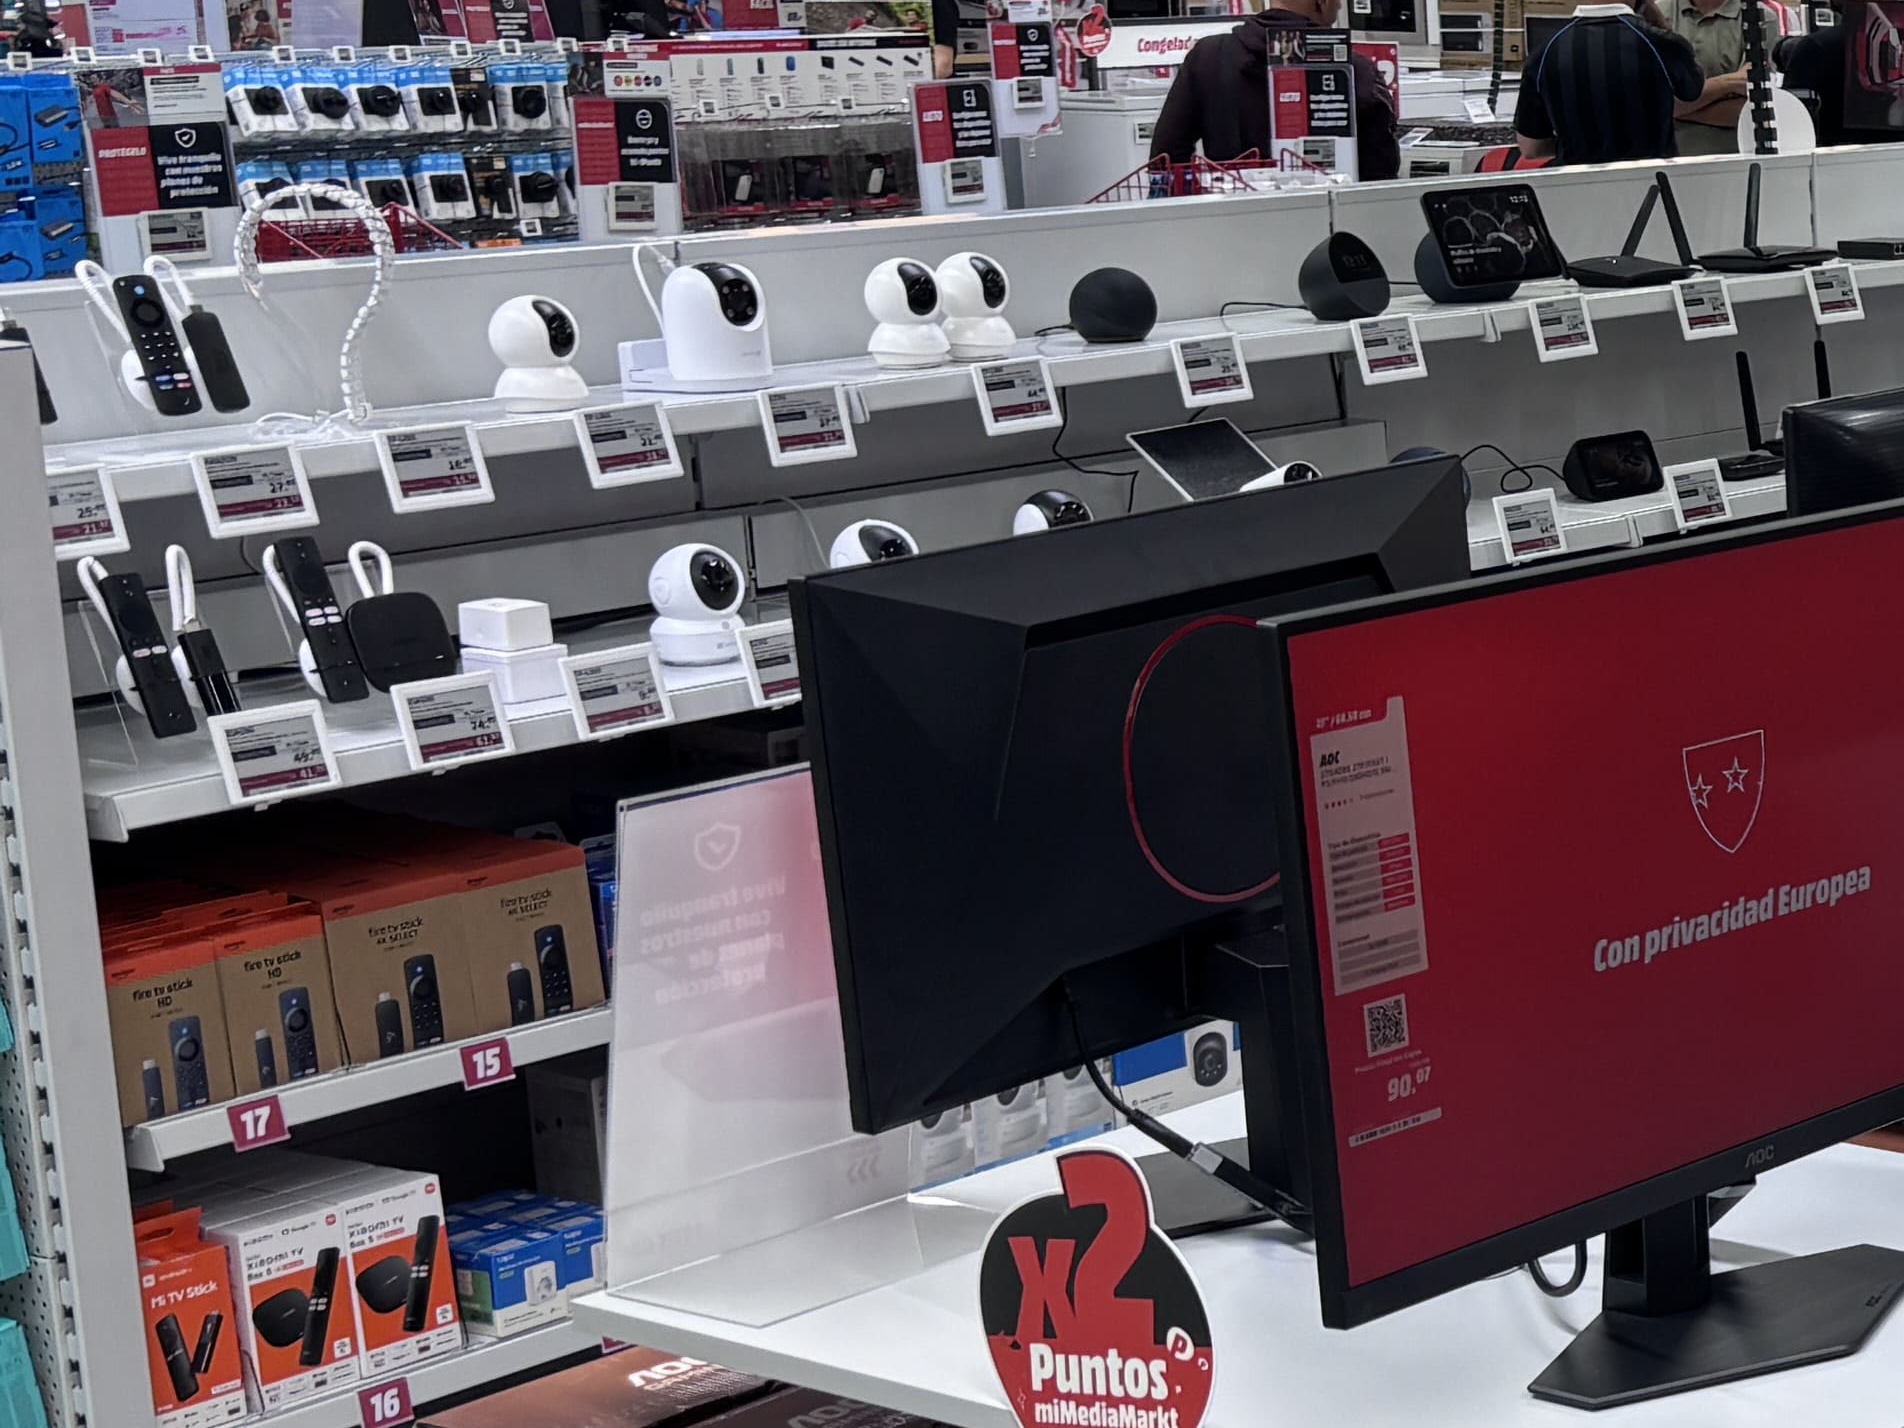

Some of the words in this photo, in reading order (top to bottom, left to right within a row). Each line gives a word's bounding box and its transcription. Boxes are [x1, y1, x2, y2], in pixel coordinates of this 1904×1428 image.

[1594, 929, 1640, 972] Con
[1645, 888, 1775, 963] privacidad
[1778, 864, 1872, 924] Europea
[473, 1047, 501, 1078] 15
[240, 1106, 271, 1138] 17
[1745, 1145, 1775, 1169] AOC
[1008, 1155, 1155, 1346] x2
[168, 1289, 186, 1303] TV
[187, 1280, 218, 1299] Stick
[1030, 1342, 1169, 1400] Puntos
[370, 1389, 400, 1420] 16
